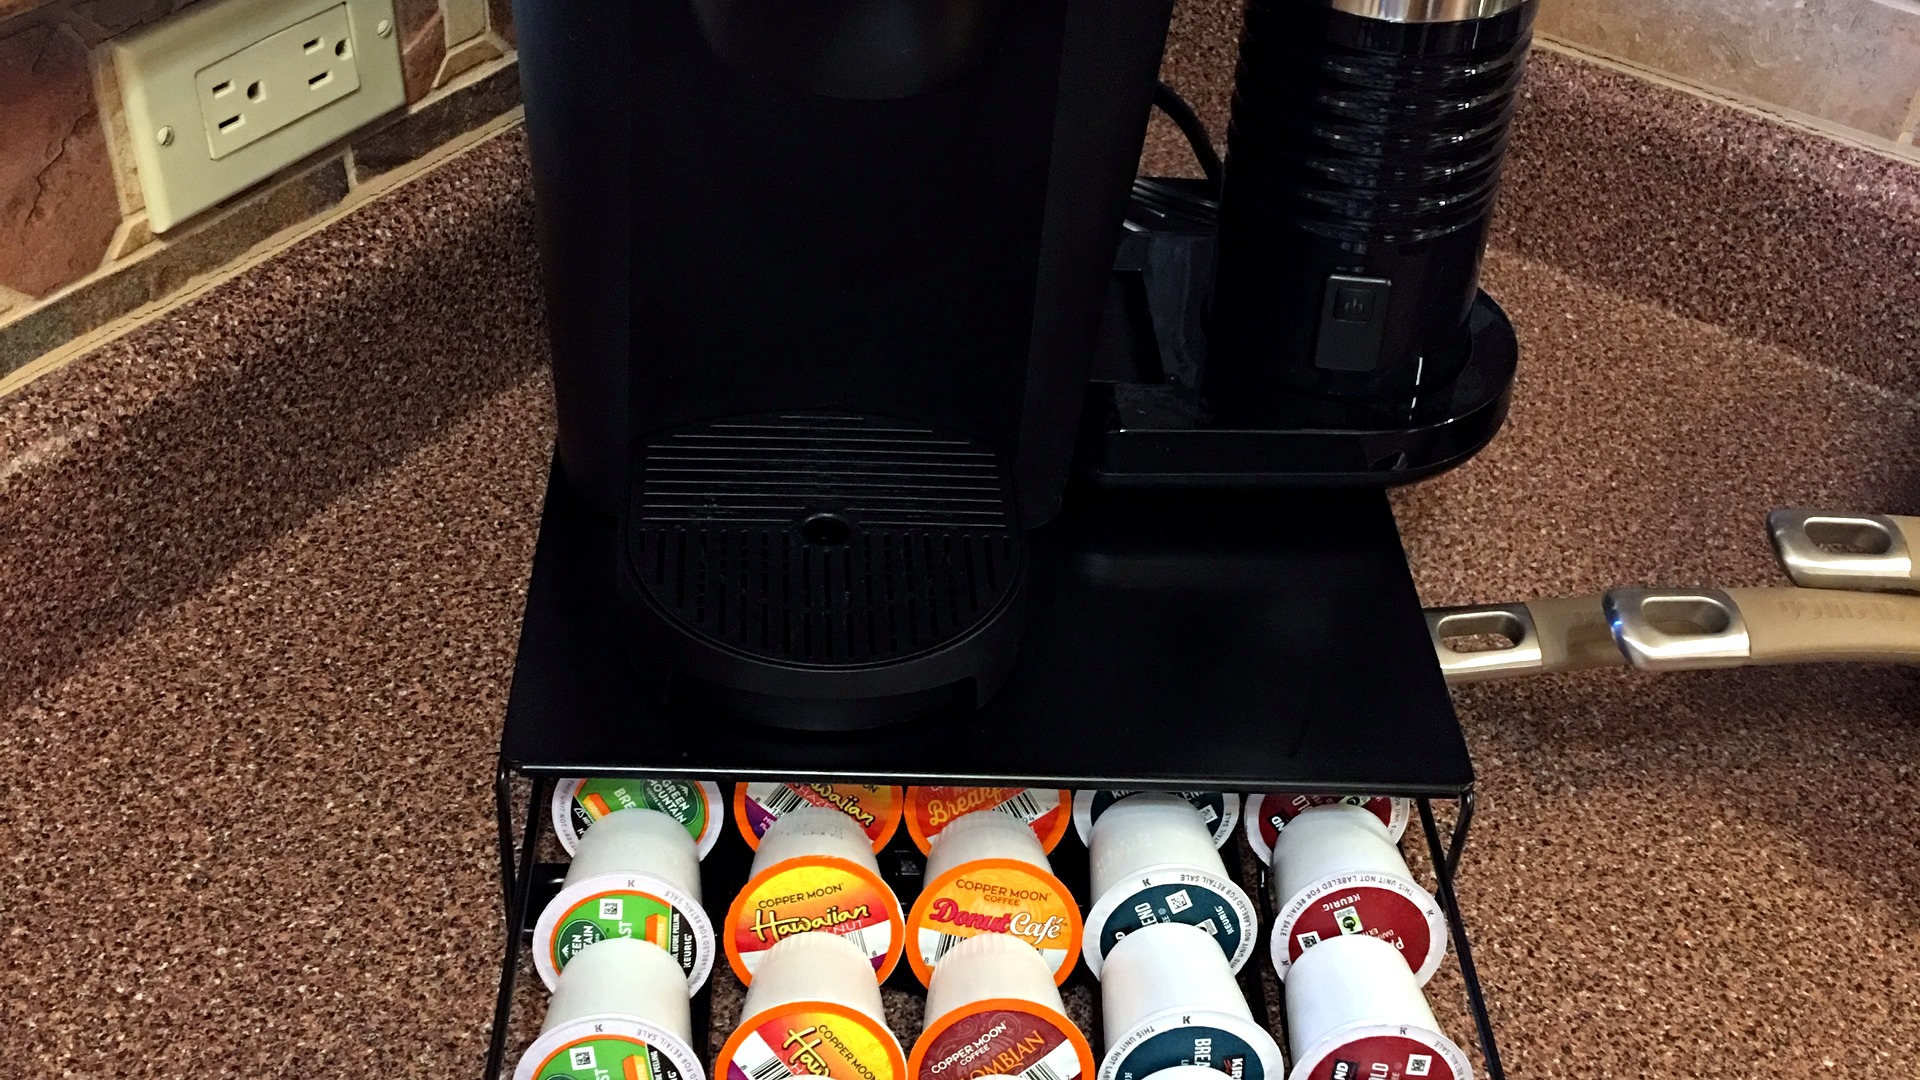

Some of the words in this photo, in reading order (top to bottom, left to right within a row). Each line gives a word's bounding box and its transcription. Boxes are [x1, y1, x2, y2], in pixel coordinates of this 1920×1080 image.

[662, 780, 690, 811] GREEN
[1142, 878, 1151, 887] K
[1180, 874, 1200, 882] SALE
[1202, 876, 1226, 892] RETAIL
[1322, 875, 1358, 891] LABELED
[1378, 877, 1397, 887] UNIT
[664, 890, 685, 904] SALE
[758, 892, 805, 909] COPPER
[806, 884, 842, 899] MOON
[956, 879, 1008, 896] COPPER
[1010, 889, 1048, 902] MOON
[1226, 888, 1240, 903] FOR
[1305, 887, 1321, 899] FOR
[1398, 884, 1414, 897] THIS
[983, 894, 1020, 907] COFFEE
[1322, 893, 1361, 912] KEURIG
[684, 903, 702, 924] RETAIL
[1236, 901, 1252, 927] LABELED
[1288, 898, 1307, 920] RETAIL
[1426, 909, 1434, 917] K
[749, 904, 870, 943] Hawaiian
[1213, 905, 1235, 936] KEURIG
[1280, 920, 1291, 937] SALE
[699, 924, 708, 938] FOR
[683, 933, 693, 968] KEURIG
[701, 940, 710, 970] LABELED
[1238, 943, 1248, 958] UNIT
[1182, 1015, 1191, 1024] K
[636, 1028, 657, 1041] SALE
[1137, 1025, 1155, 1039] THIS
[660, 1038, 683, 1060] RETAIL
[818, 1024, 854, 1061] COPPER
[931, 1044, 972, 1073] COPPER
[974, 1022, 1007, 1048] MOON
[1121, 1037, 1137, 1053] UNIT
[1434, 1040, 1451, 1056] SALE
[960, 1043, 991, 1066] COFFEE
[1110, 1051, 1123, 1065] NOT
